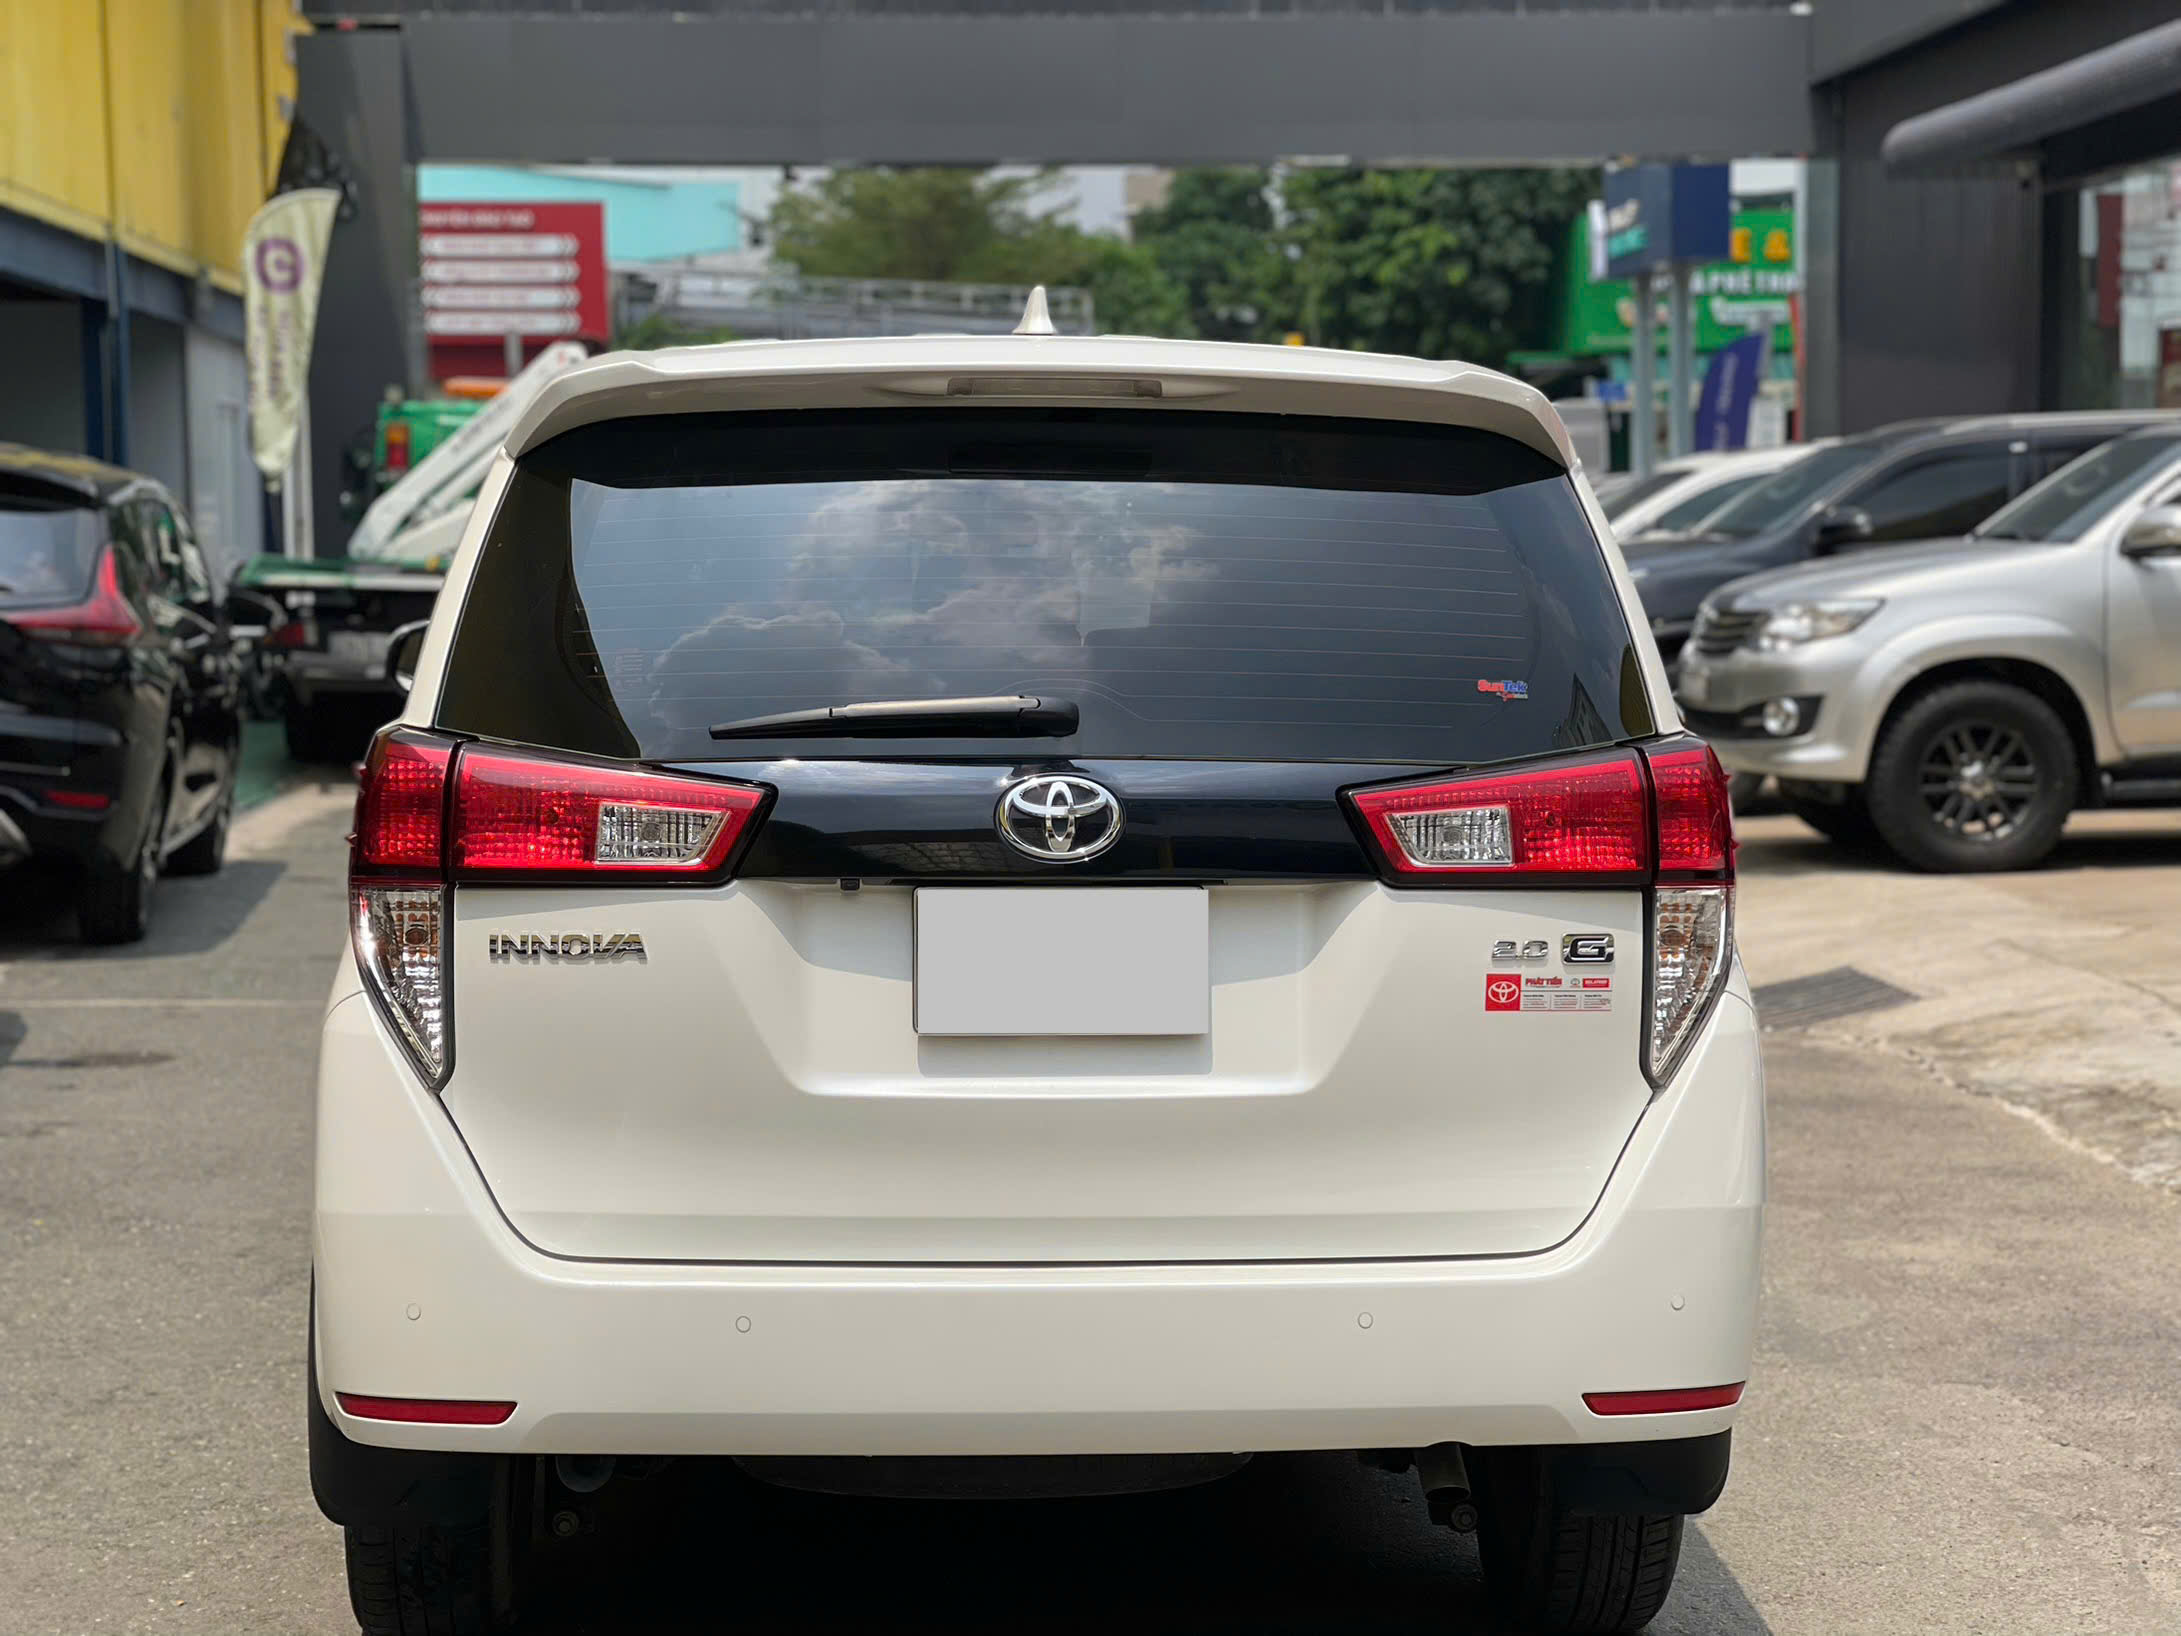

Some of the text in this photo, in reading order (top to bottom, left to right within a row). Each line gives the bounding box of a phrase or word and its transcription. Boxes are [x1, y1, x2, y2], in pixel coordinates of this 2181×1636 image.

[488, 933, 649, 961] INNOVA
[1492, 935, 1611, 963] 2.0 G
